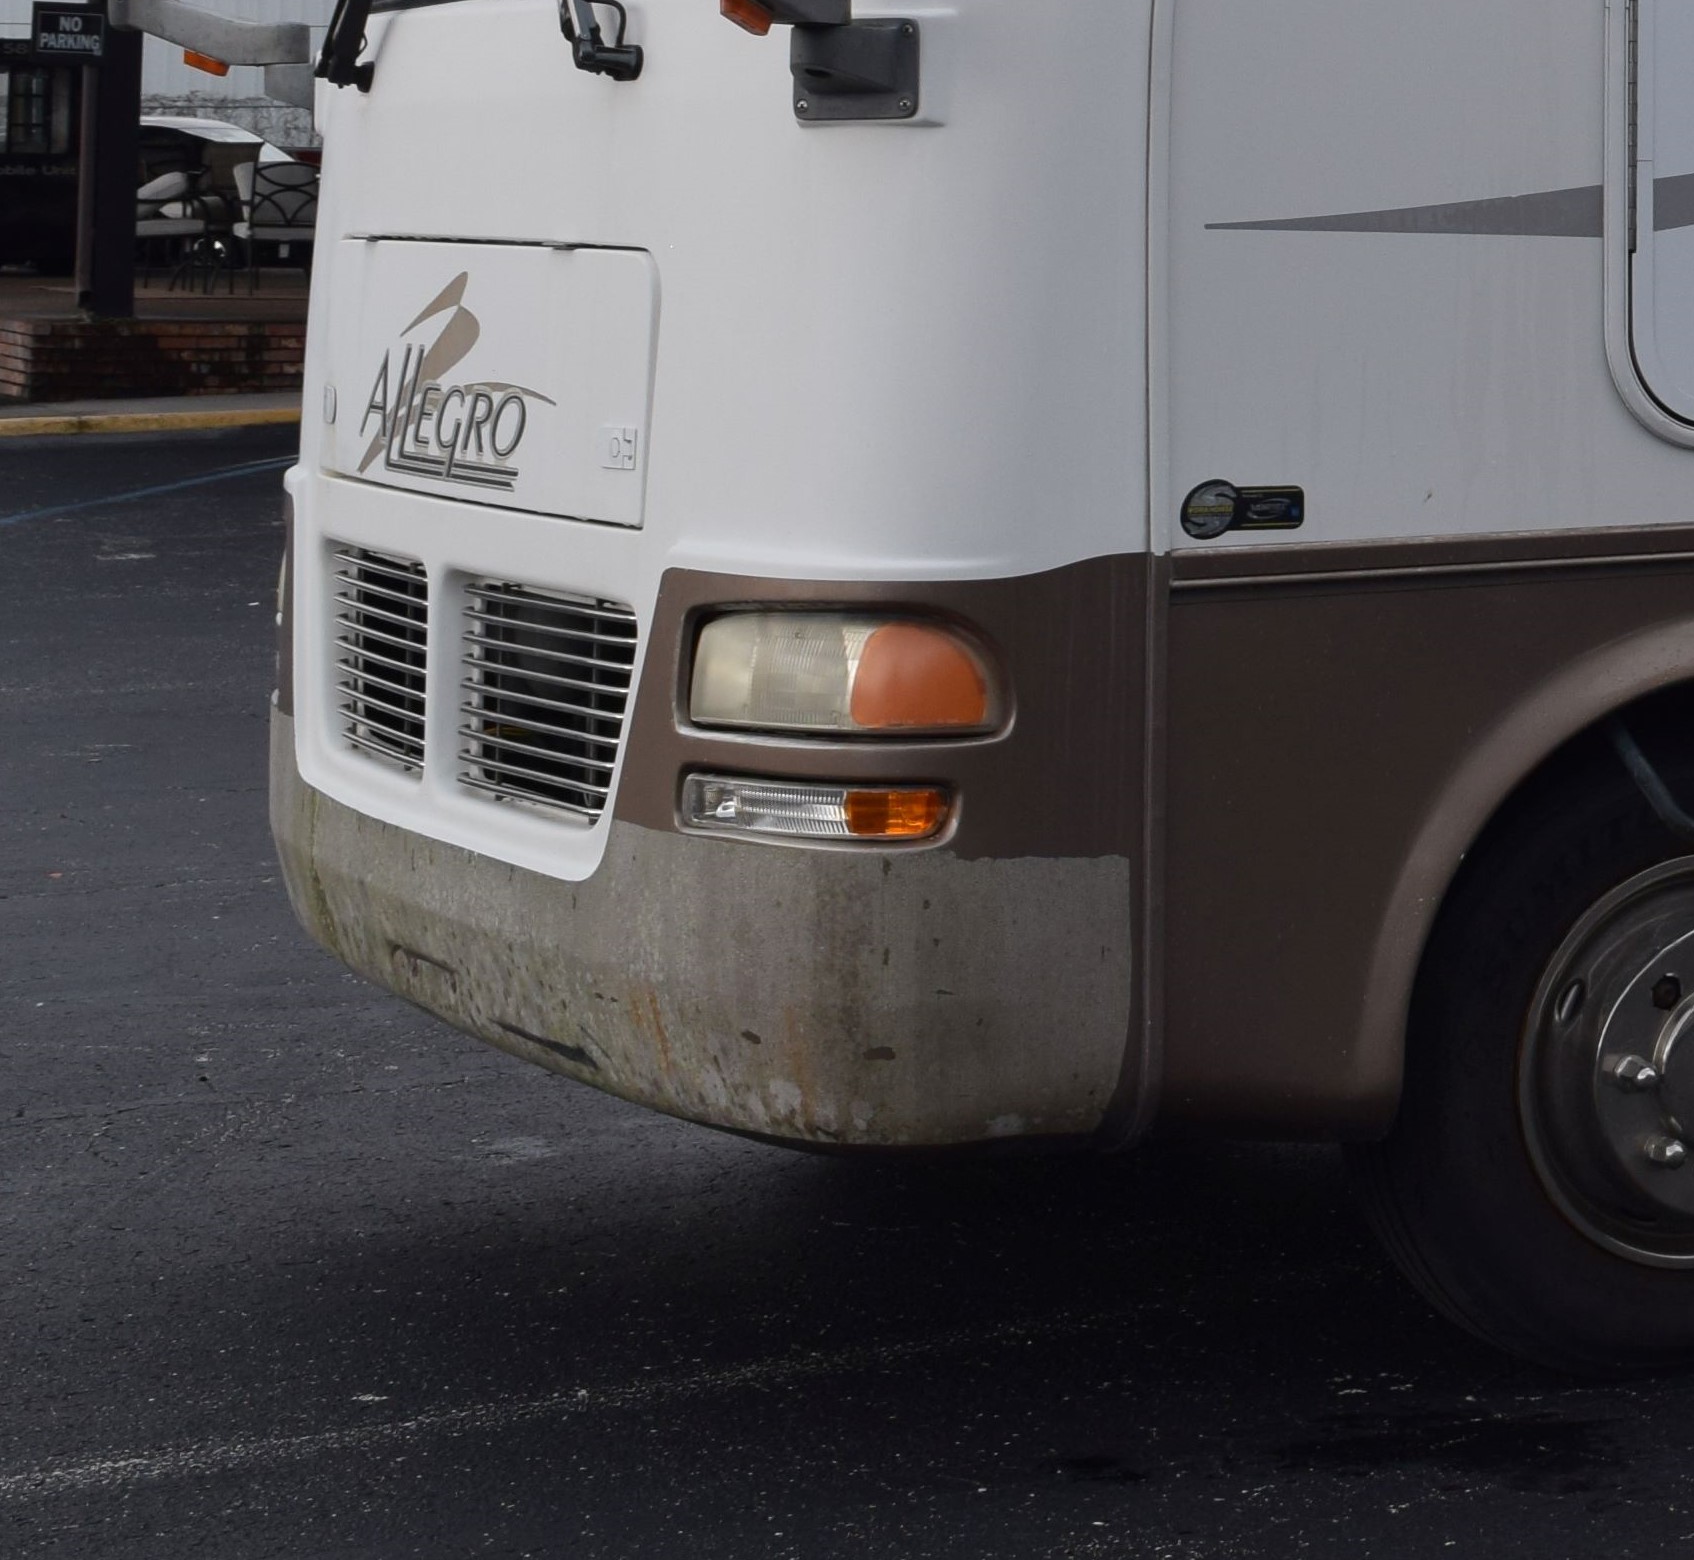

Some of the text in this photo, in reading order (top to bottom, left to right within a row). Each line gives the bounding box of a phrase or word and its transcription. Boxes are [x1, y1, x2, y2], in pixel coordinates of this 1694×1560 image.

[59, 16, 83, 32] NO
[39, 32, 101, 50] PARKING
[359, 342, 527, 488] ALLEGRO
